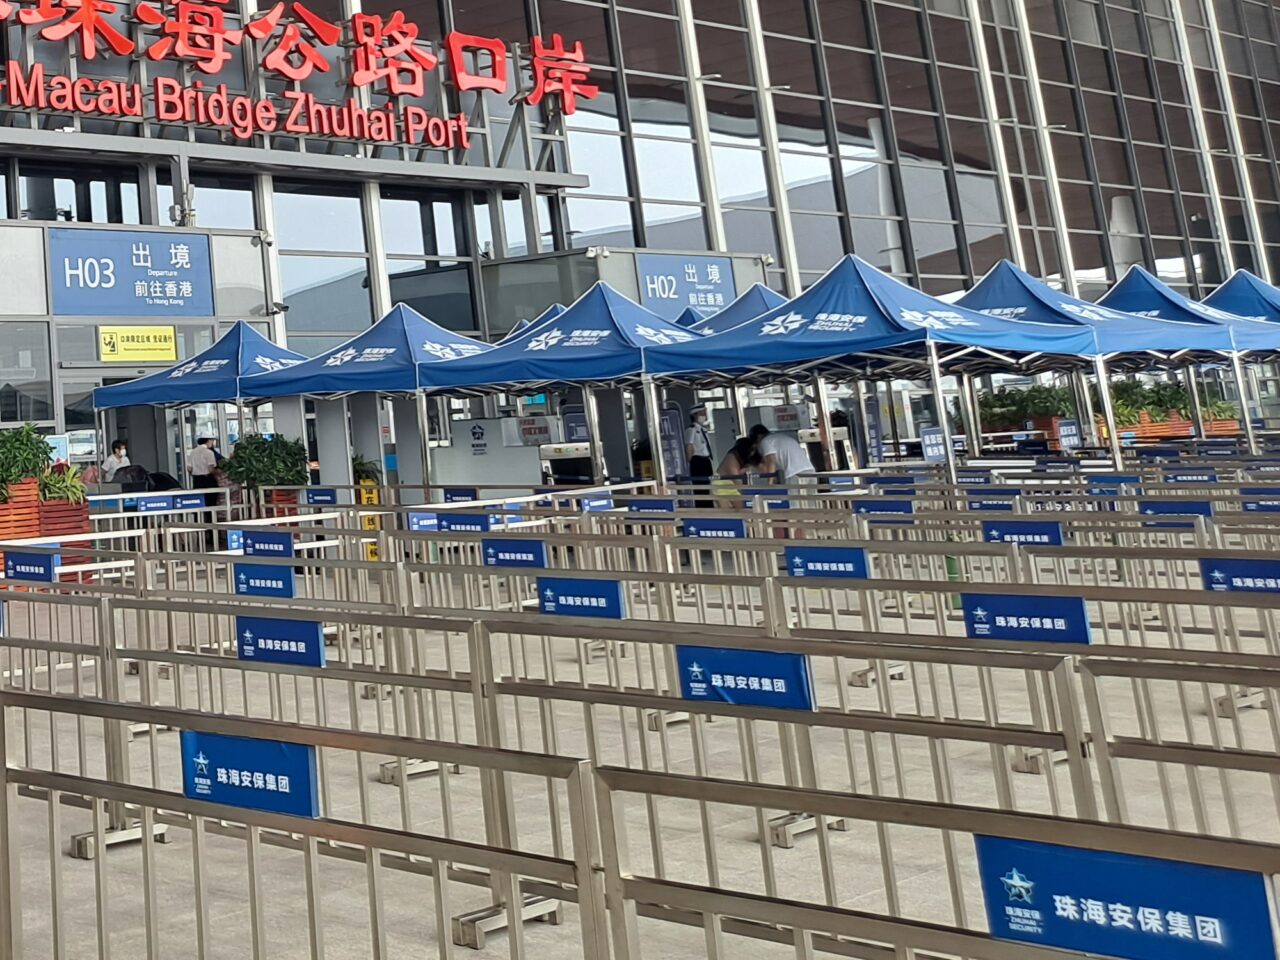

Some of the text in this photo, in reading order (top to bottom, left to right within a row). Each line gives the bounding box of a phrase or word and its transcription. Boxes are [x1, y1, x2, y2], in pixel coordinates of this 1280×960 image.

[156, 77, 278, 139] Bridge
[284, 91, 396, 142] Zhuhai
[406, 107, 472, 150] Port
[64, 257, 116, 288] H03
[148, 269, 178, 277] Departure
[134, 280, 193, 297] 前往香港
[646, 275, 679, 298] H02
[154, 298, 169, 306] Hong
[170, 298, 184, 306] Kong
[995, 616, 1066, 630] 珠海安保集团
[711, 673, 786, 693] 珠海安保集团
[216, 767, 291, 793] 珠海安保集团
[1052, 893, 1223, 945] 珠海安保集团
